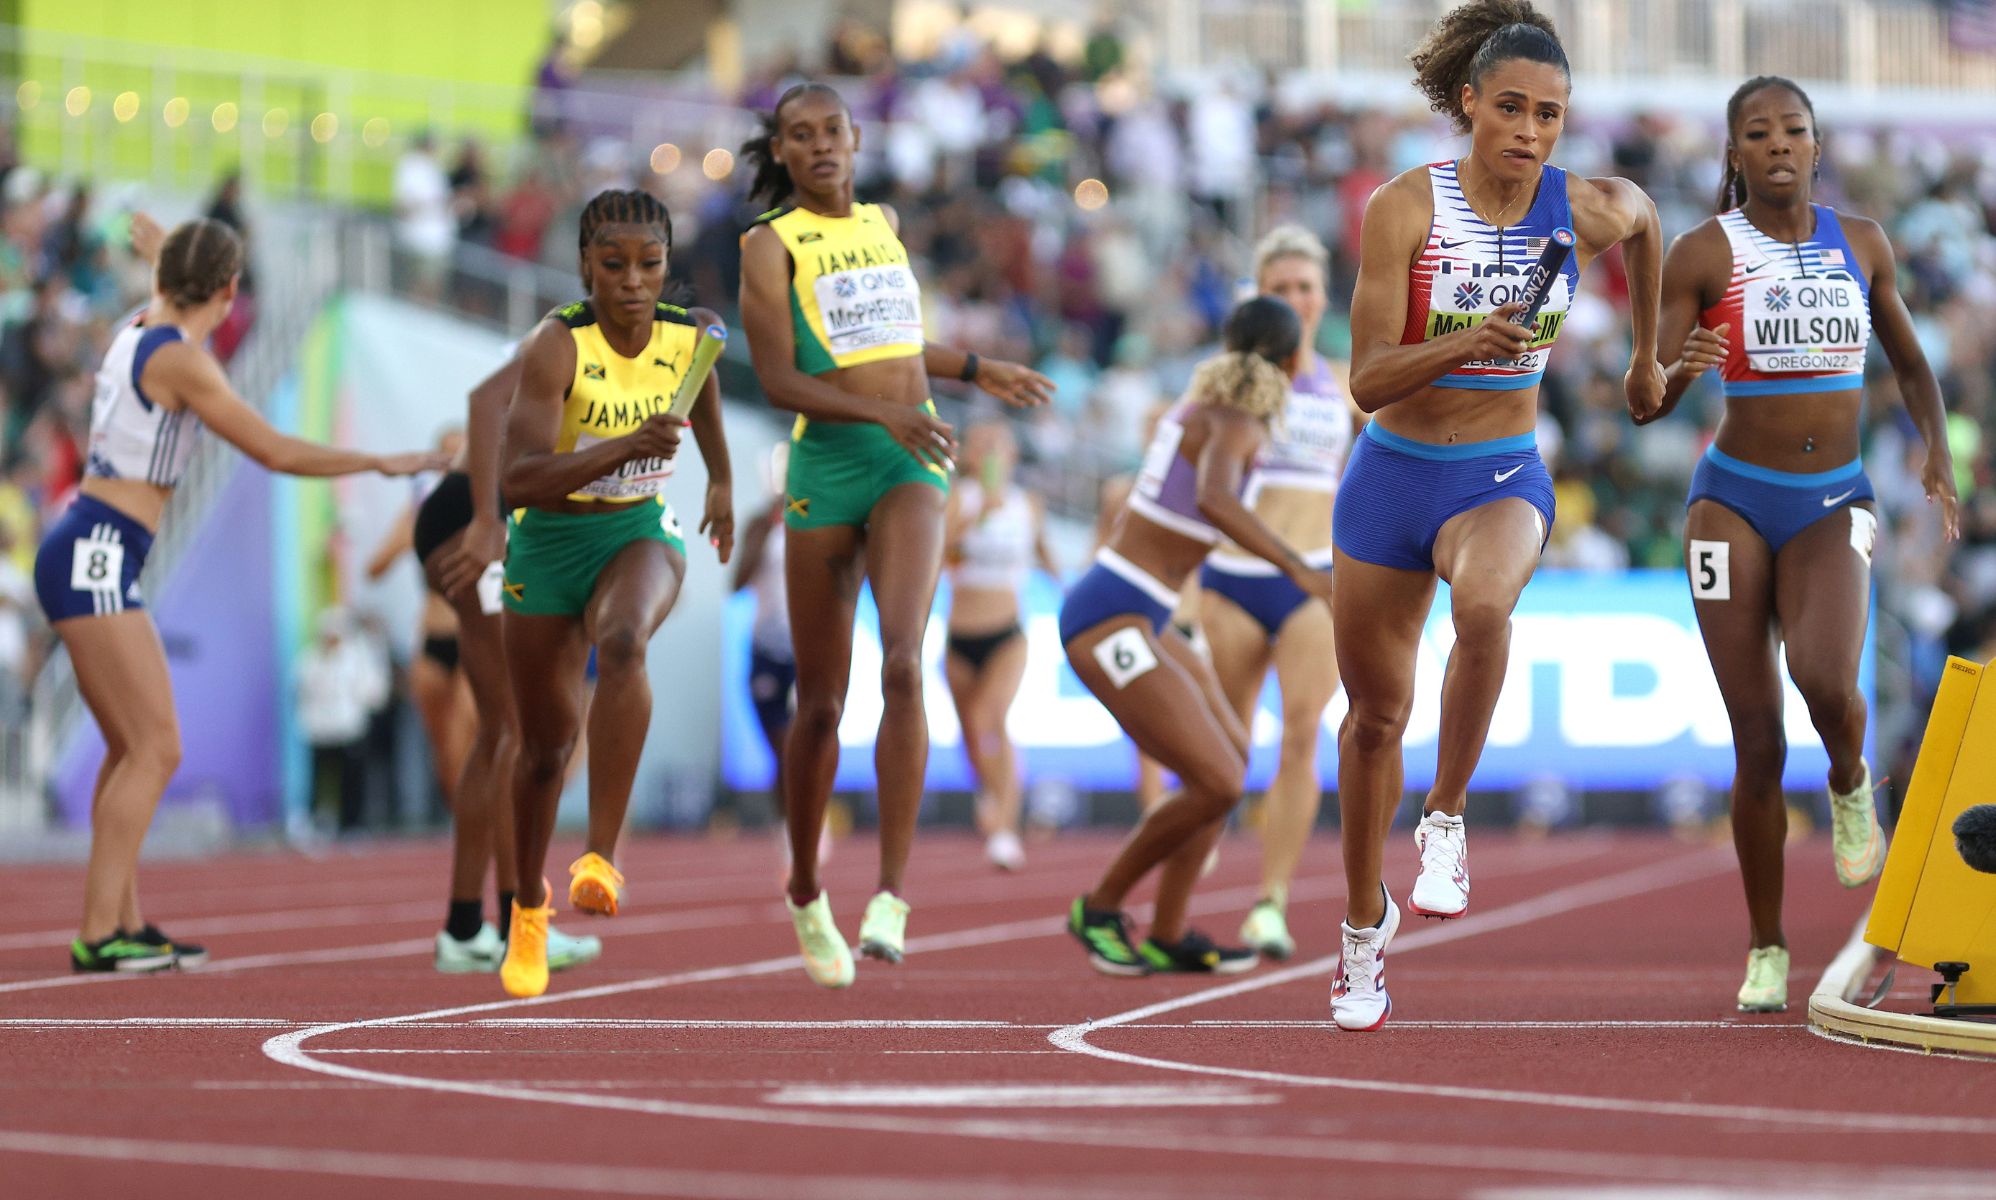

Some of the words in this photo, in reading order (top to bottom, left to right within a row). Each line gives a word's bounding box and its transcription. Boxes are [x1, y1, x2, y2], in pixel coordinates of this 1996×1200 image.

[816, 244, 902, 277] JAMAIC
[861, 270, 906, 290] QNB
[1508, 264, 1551, 327] REGON22
[1797, 286, 1850, 308] QNB
[828, 297, 918, 329] McPHERSON
[1754, 316, 1860, 346] WILSON
[1767, 355, 1849, 370] OREGON22
[580, 390, 678, 428] JAMAIC
[87, 551, 106, 580] 8
[1699, 551, 1717, 590] 5
[1113, 640, 1136, 671] 6
